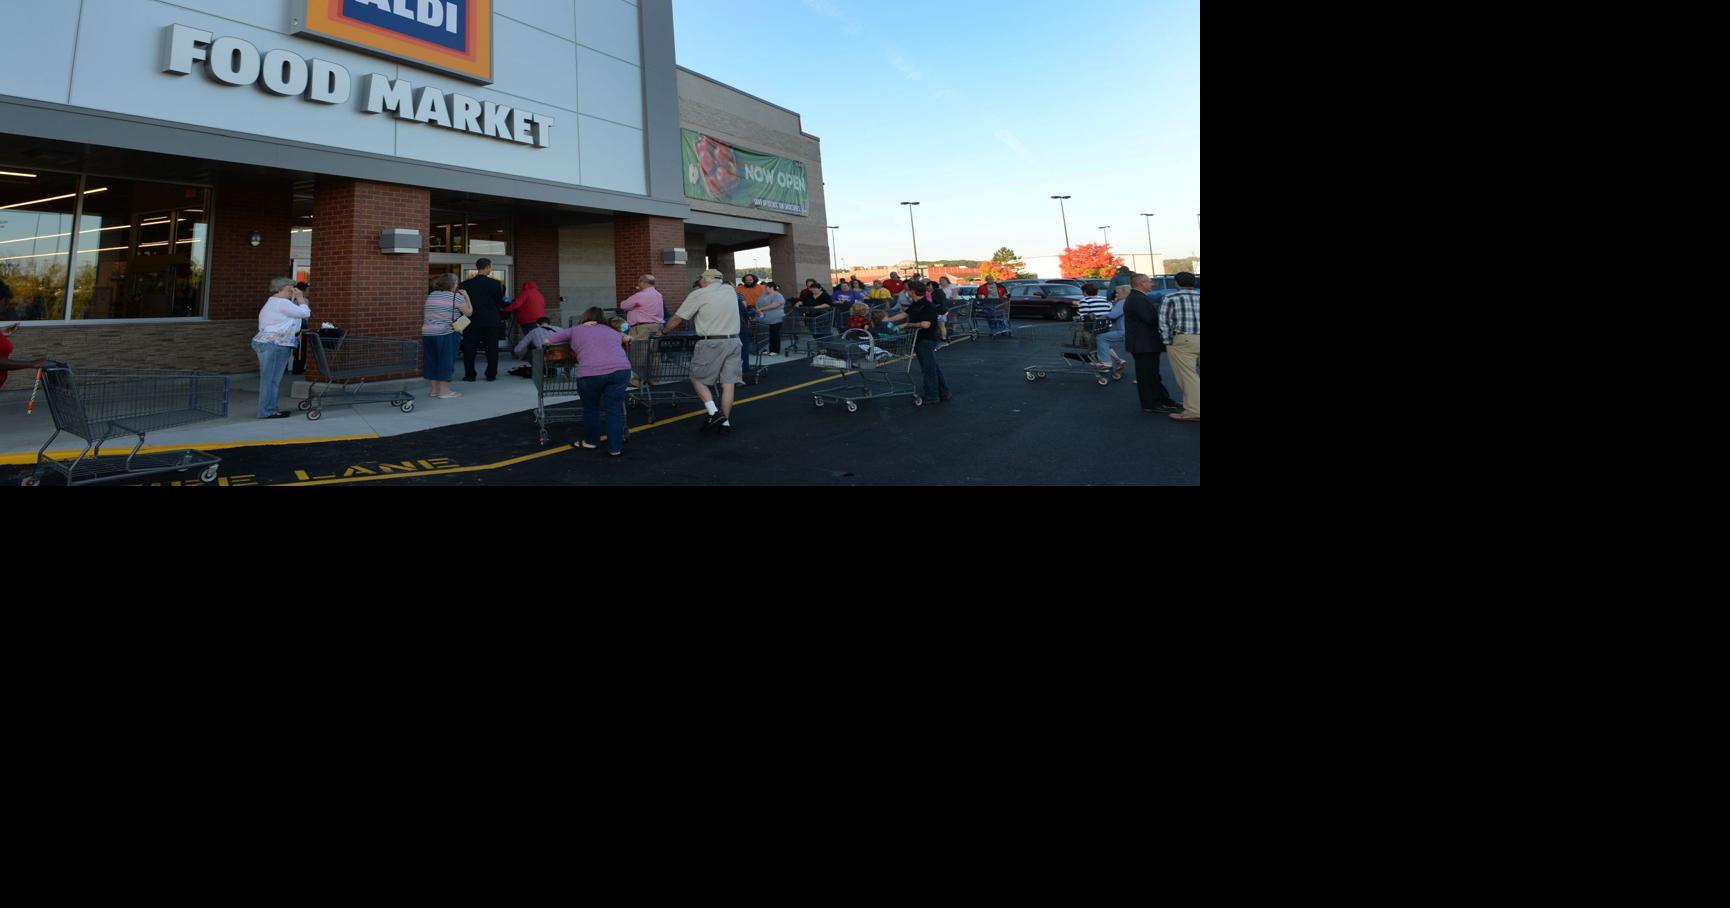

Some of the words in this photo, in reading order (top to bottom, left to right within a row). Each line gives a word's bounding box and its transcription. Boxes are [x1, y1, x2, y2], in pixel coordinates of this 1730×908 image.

[162, 23, 351, 105] FOOD
[360, 72, 555, 149] MARKET
[744, 164, 775, 185] NOW
[777, 172, 806, 192] OPEN
[294, 458, 460, 480] LANE
